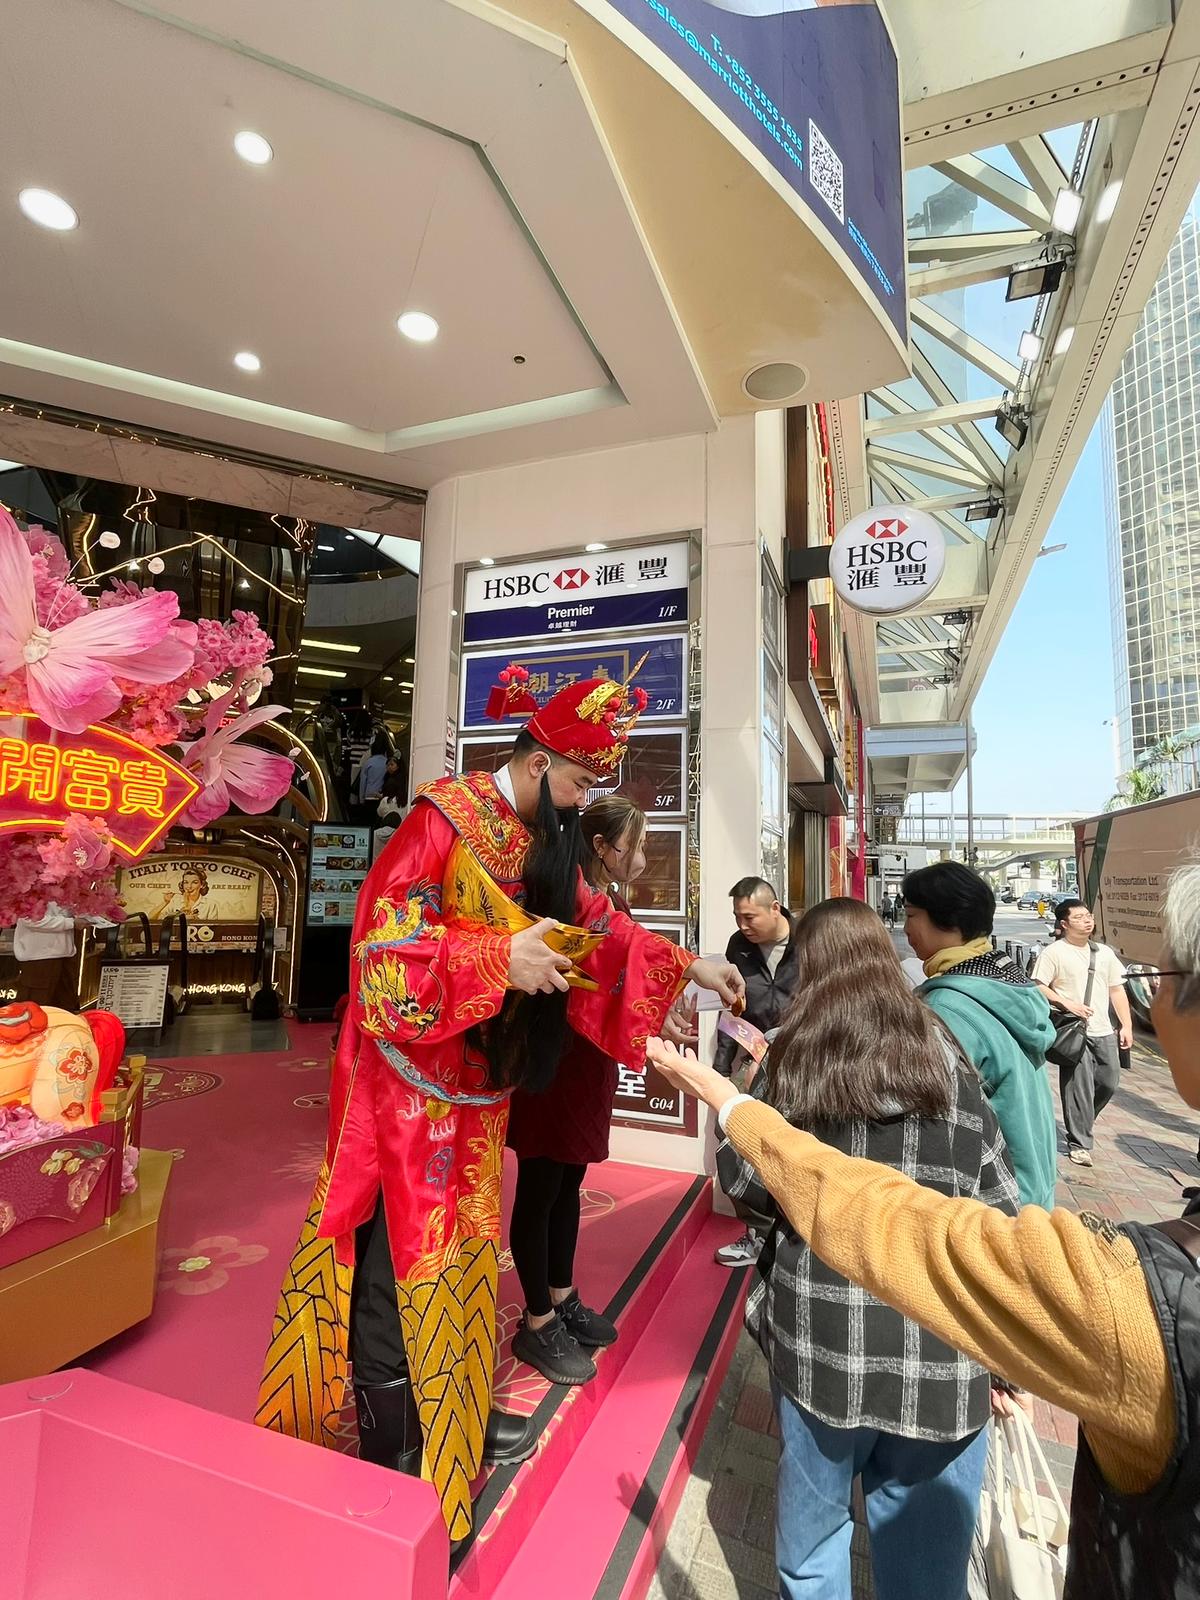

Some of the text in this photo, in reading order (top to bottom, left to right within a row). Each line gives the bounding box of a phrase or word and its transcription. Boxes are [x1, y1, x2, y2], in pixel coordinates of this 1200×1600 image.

[644, 0, 803, 172] sales@marriotthotels.com
[710, 33, 803, 152] T: +852 3555 1635
[846, 540, 928, 568] HSBC
[483, 572, 550, 600] HSBC
[547, 604, 678, 619] Premier 1/F
[655, 698, 676, 711] 2/F
[654, 795, 675, 807] 5/F
[128, 861, 257, 881] ITALY TOKYO CHEF
[187, 983, 246, 995] HONG KONG
[649, 1097, 674, 1111] G04
